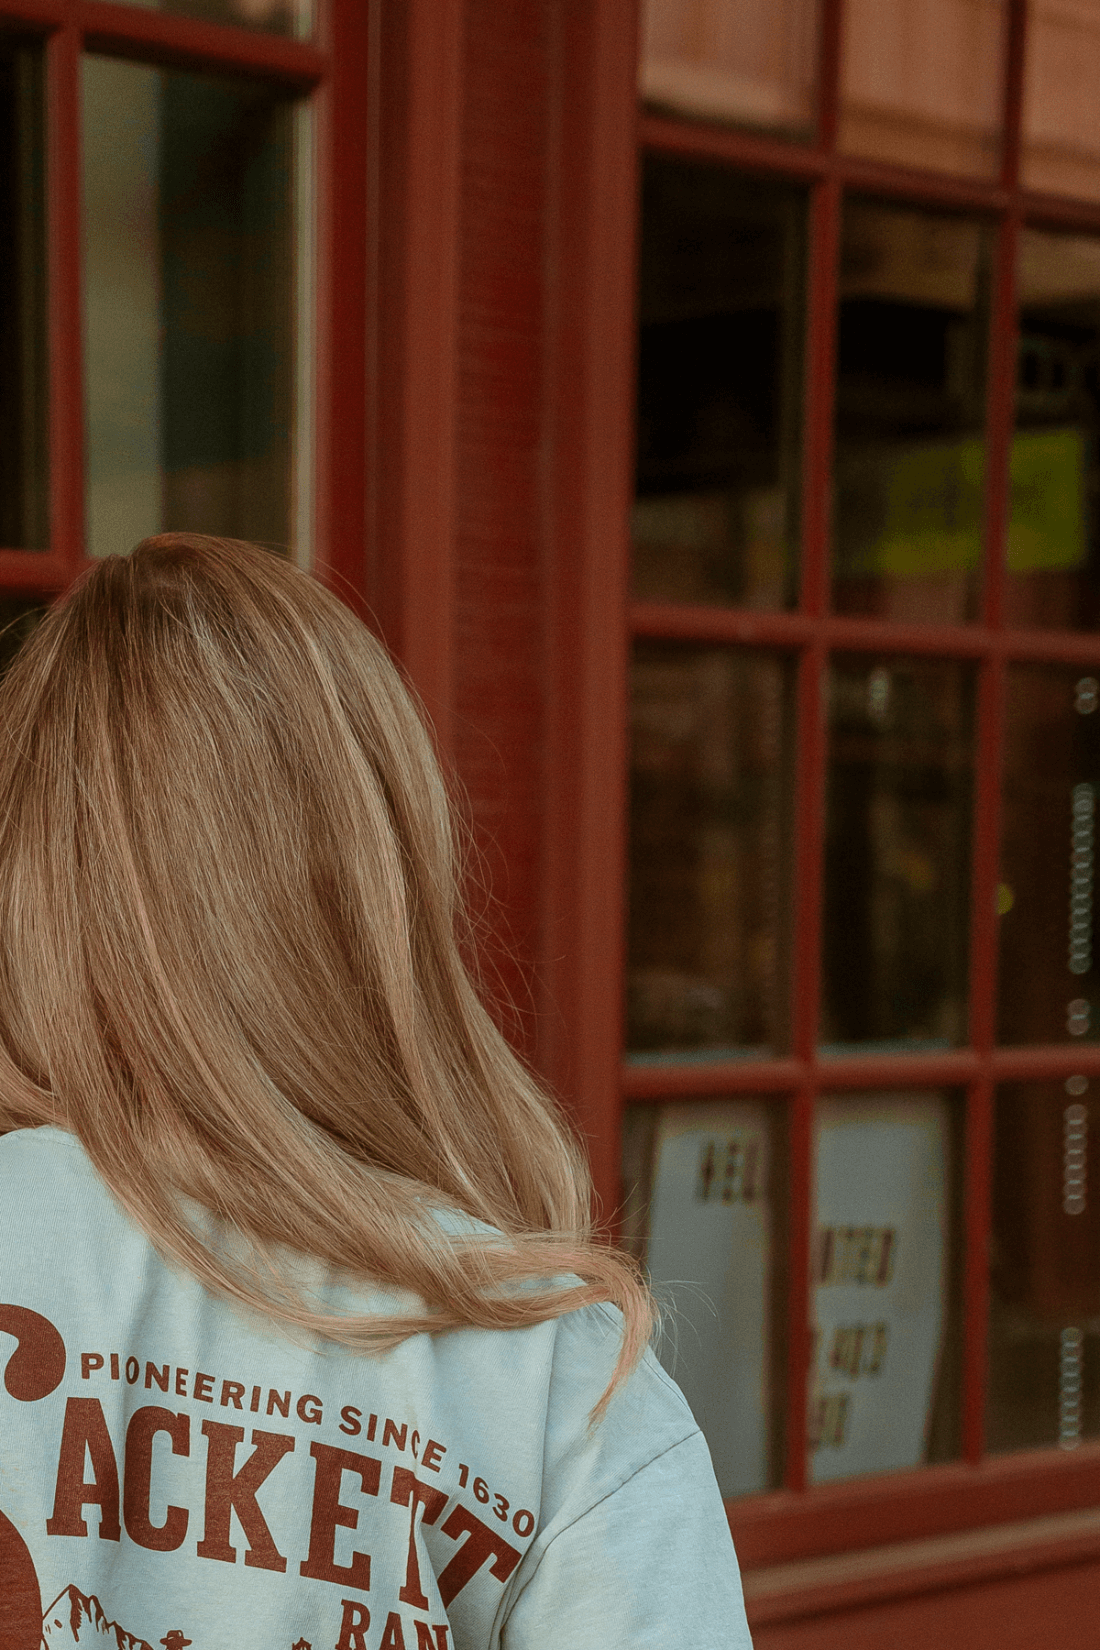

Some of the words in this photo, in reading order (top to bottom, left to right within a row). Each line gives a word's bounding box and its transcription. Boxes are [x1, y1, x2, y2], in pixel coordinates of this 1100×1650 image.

[80, 1352, 323, 1426] PIONEERING
[338, 1405, 448, 1473] SINCE
[458, 1463, 536, 1539] 1630
